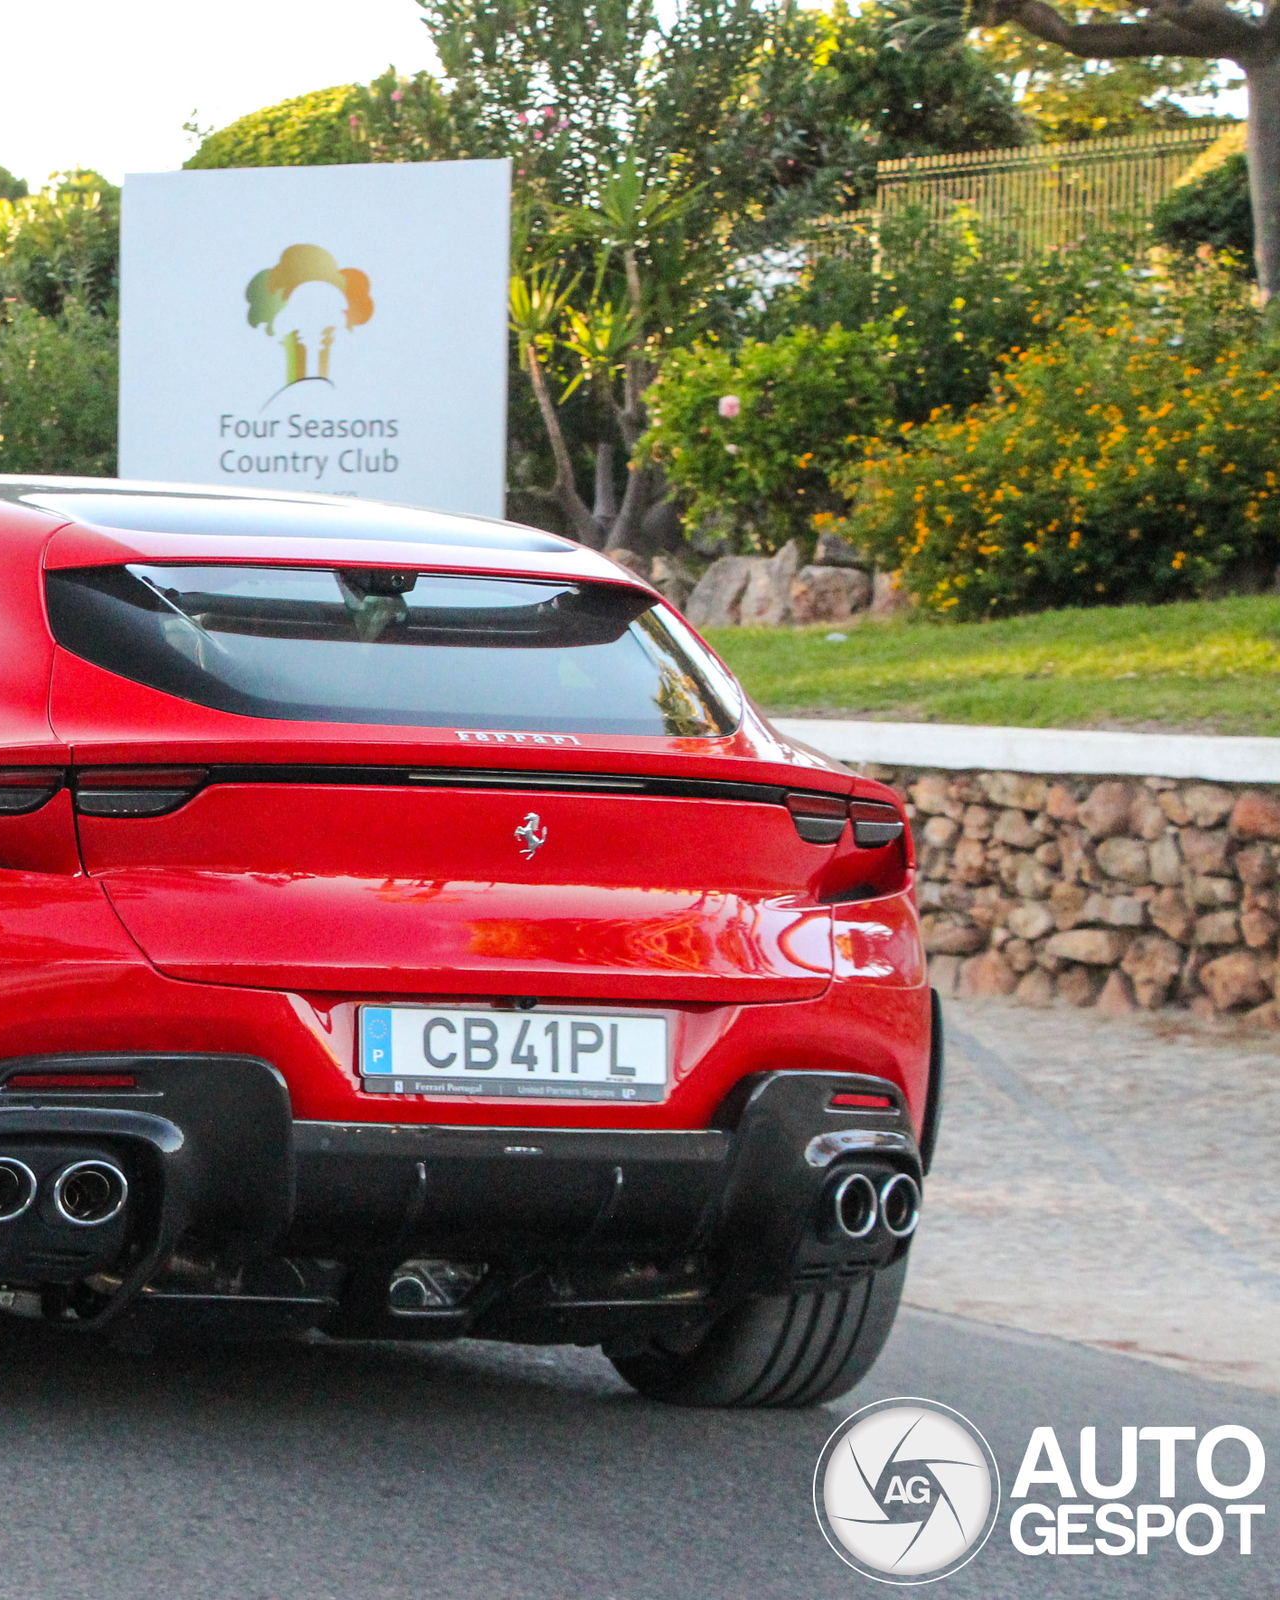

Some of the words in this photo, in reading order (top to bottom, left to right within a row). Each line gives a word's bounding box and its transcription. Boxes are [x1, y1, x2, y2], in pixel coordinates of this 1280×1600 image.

[219, 414, 280, 438] Four
[288, 414, 399, 438] Seasons
[219, 449, 328, 479] Country
[338, 447, 399, 473] Club
[454, 731, 582, 746] Ferrari
[423, 1016, 499, 1071] CB
[372, 1049, 384, 1063] P
[415, 1081, 445, 1093] Ferrari
[446, 1082, 483, 1095] Portugal
[517, 1084, 543, 1095] United
[545, 1086, 581, 1097] Partners
